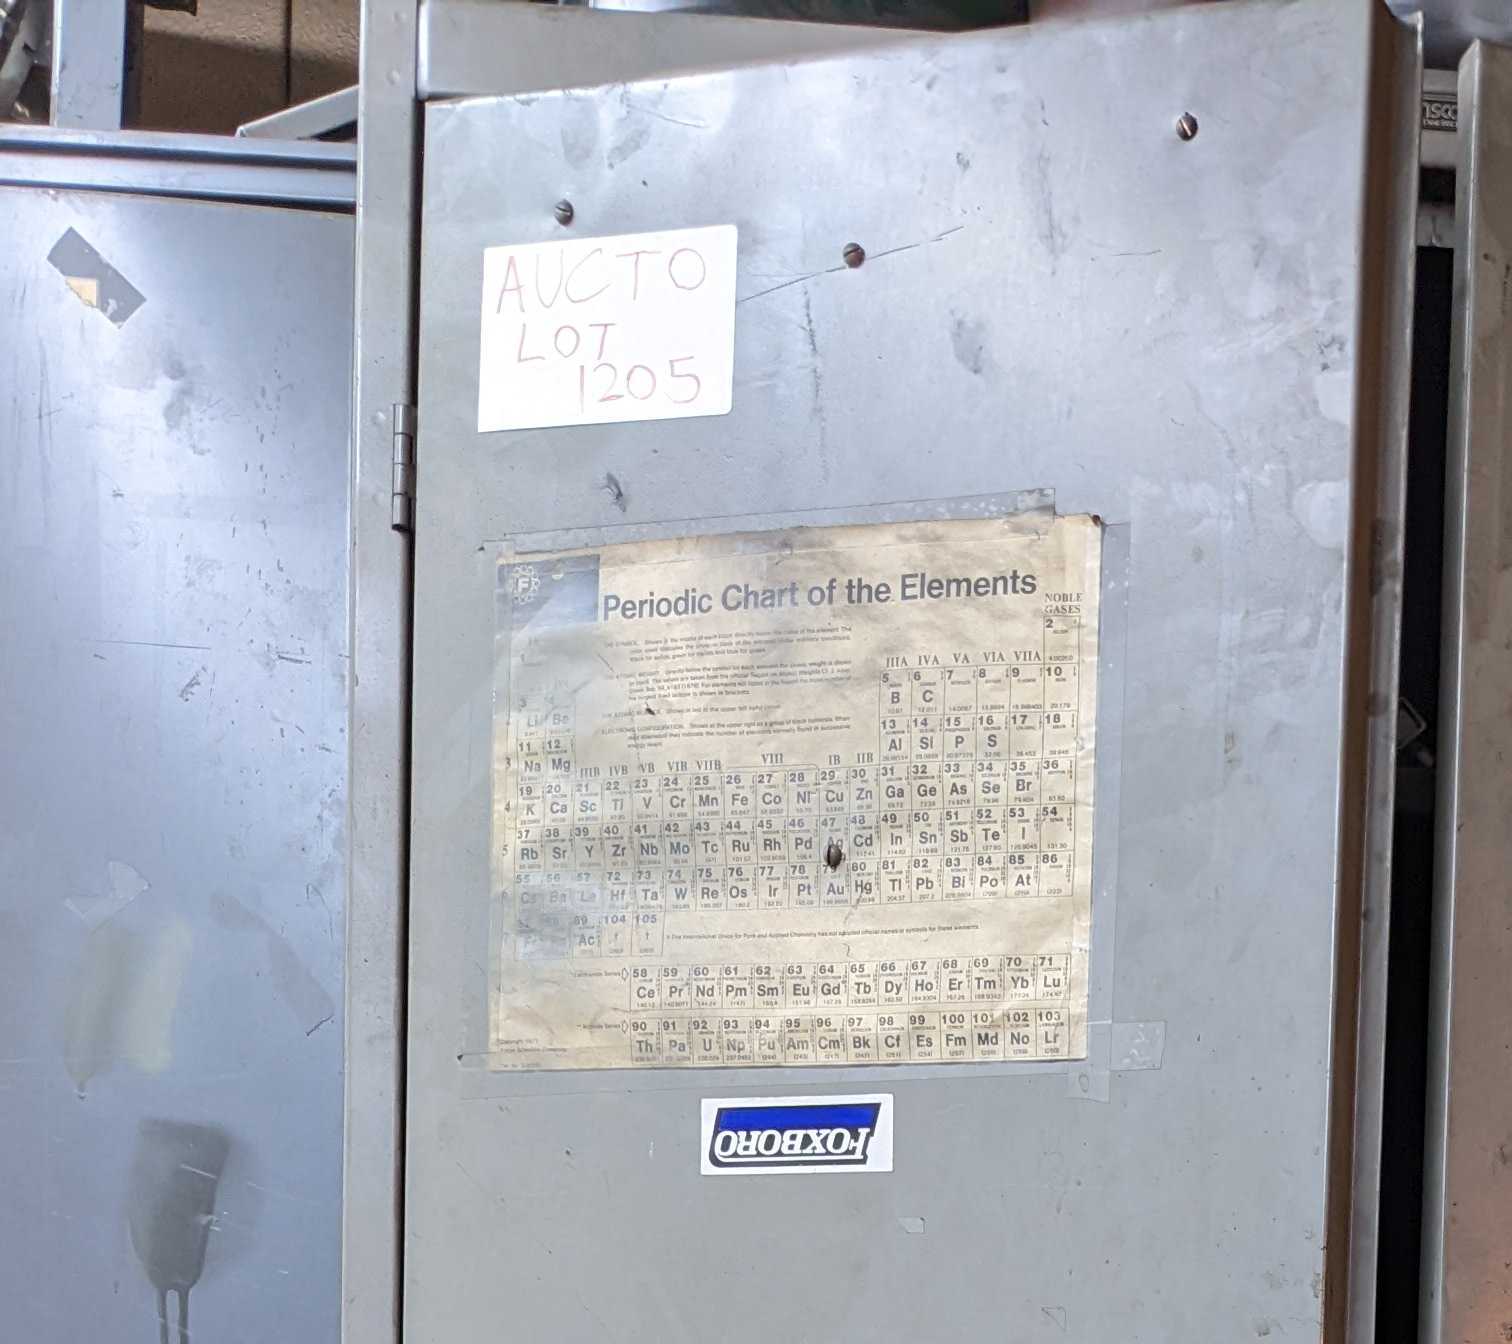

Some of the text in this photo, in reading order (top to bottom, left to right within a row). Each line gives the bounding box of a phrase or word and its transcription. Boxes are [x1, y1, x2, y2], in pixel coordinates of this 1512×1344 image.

[496, 248, 706, 314] AUCTO
[517, 322, 616, 362] LOT
[579, 356, 701, 414] 1205
[603, 570, 1038, 621] Periodic Chart of the Elements
[1045, 592, 1082, 602] NOBLE
[1044, 604, 1080, 614] GASES
[1046, 619, 1054, 628] 2
[886, 651, 1041, 668] IIIA IVA VA VIA VIIA
[882, 666, 1062, 683] 5 6 7 8 9 10
[890, 690, 933, 704] B C
[881, 714, 1060, 730] 13 14 15 16 17 18
[955, 736, 964, 748] P
[988, 734, 997, 747] S
[762, 753, 783, 764] VIII
[829, 755, 840, 765] IB
[857, 753, 873, 763] IIB
[526, 779, 1032, 815] K Ca Sc V Cr Mn Fe Co Cu Zn Ga Ge As Se Br
[521, 849, 538, 859] Rb
[552, 847, 567, 859] Sr
[585, 846, 594, 857] Y
[612, 845, 625, 856] Zr
[641, 844, 658, 855] Nb
[670, 843, 689, 855] Mo
[702, 841, 718, 853] Tc
[733, 840, 749, 852] Ru
[764, 839, 781, 851] Rh
[795, 837, 812, 849] Pd
[854, 834, 872, 847] Cd
[891, 833, 902, 845] In
[919, 832, 937, 843] Sn
[950, 830, 968, 842] Sb
[982, 828, 1000, 841] Te
[642, 889, 657, 900] Ta
[675, 888, 687, 899] W
[702, 888, 718, 898] Re
[730, 886, 747, 898] Os
[769, 885, 778, 897] Ir
[798, 884, 811, 896] Pt
[827, 883, 844, 895] Au
[855, 881, 872, 894] Hg
[916, 878, 934, 890] Pb
[980, 876, 998, 887] Po
[1015, 874, 1031, 886] At
[637, 976, 1060, 998] Ce Pr Nd Pm Sm Eu Gd Tb Dy Ho Er Tm Yb Lu
[942, 1014, 965, 1023] 100
[1006, 1012, 1028, 1022] 102
[1038, 1012, 1061, 1021] 103
[636, 1032, 1059, 1054] Th Pa U Np Pu Am Cm Bk Cf Es Fm Md No Lr
[714, 1128, 870, 1160] FOXBORO
